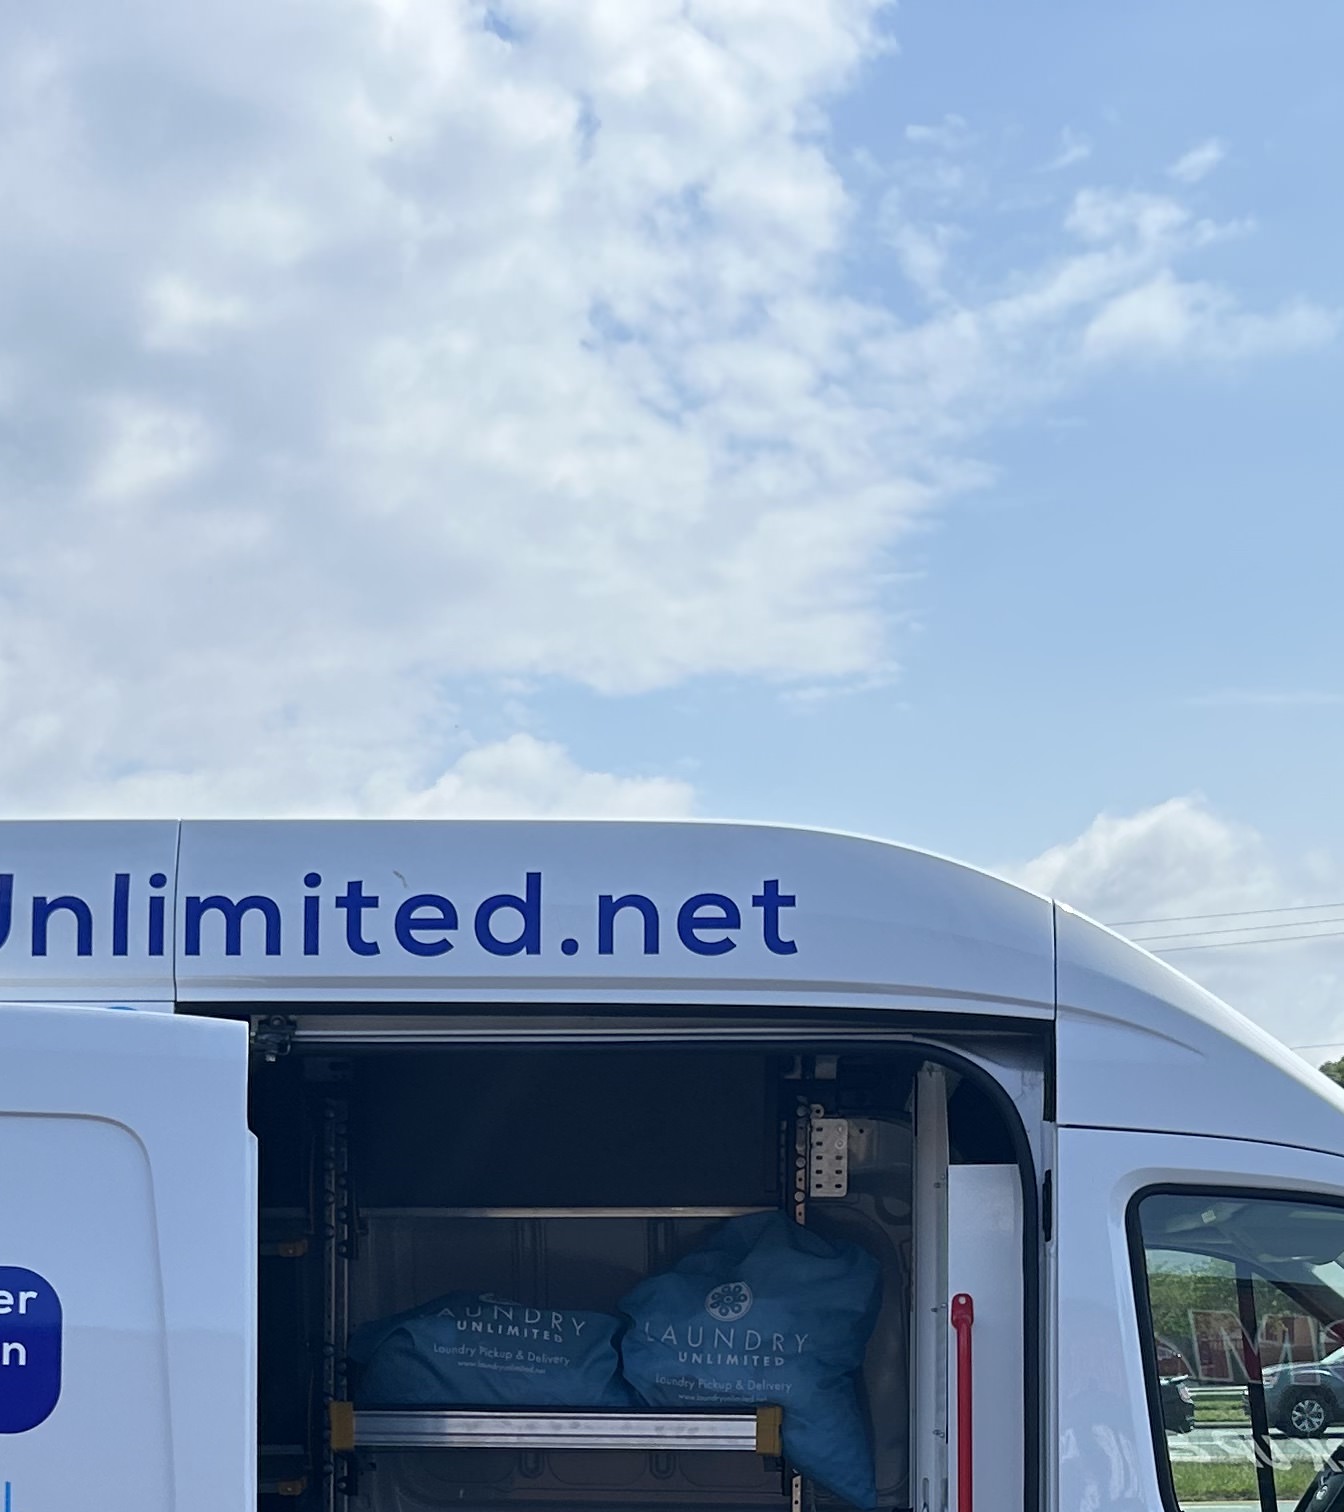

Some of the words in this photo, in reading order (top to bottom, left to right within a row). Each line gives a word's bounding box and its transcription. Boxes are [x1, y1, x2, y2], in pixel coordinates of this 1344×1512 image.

[437, 1305, 586, 1337] AUNDRY
[457, 1321, 564, 1343] UNLIMITED
[644, 1321, 809, 1353] LAUNDRY
[434, 1344, 477, 1357] Laundry
[480, 1346, 513, 1361] Pickup
[516, 1350, 524, 1360] &
[528, 1352, 570, 1366] Delivery
[678, 1352, 785, 1367] UNLIMITED
[698, 1378, 732, 1392] Pickup
[736, 1380, 744, 1390] &
[747, 1379, 793, 1393] Delivery
